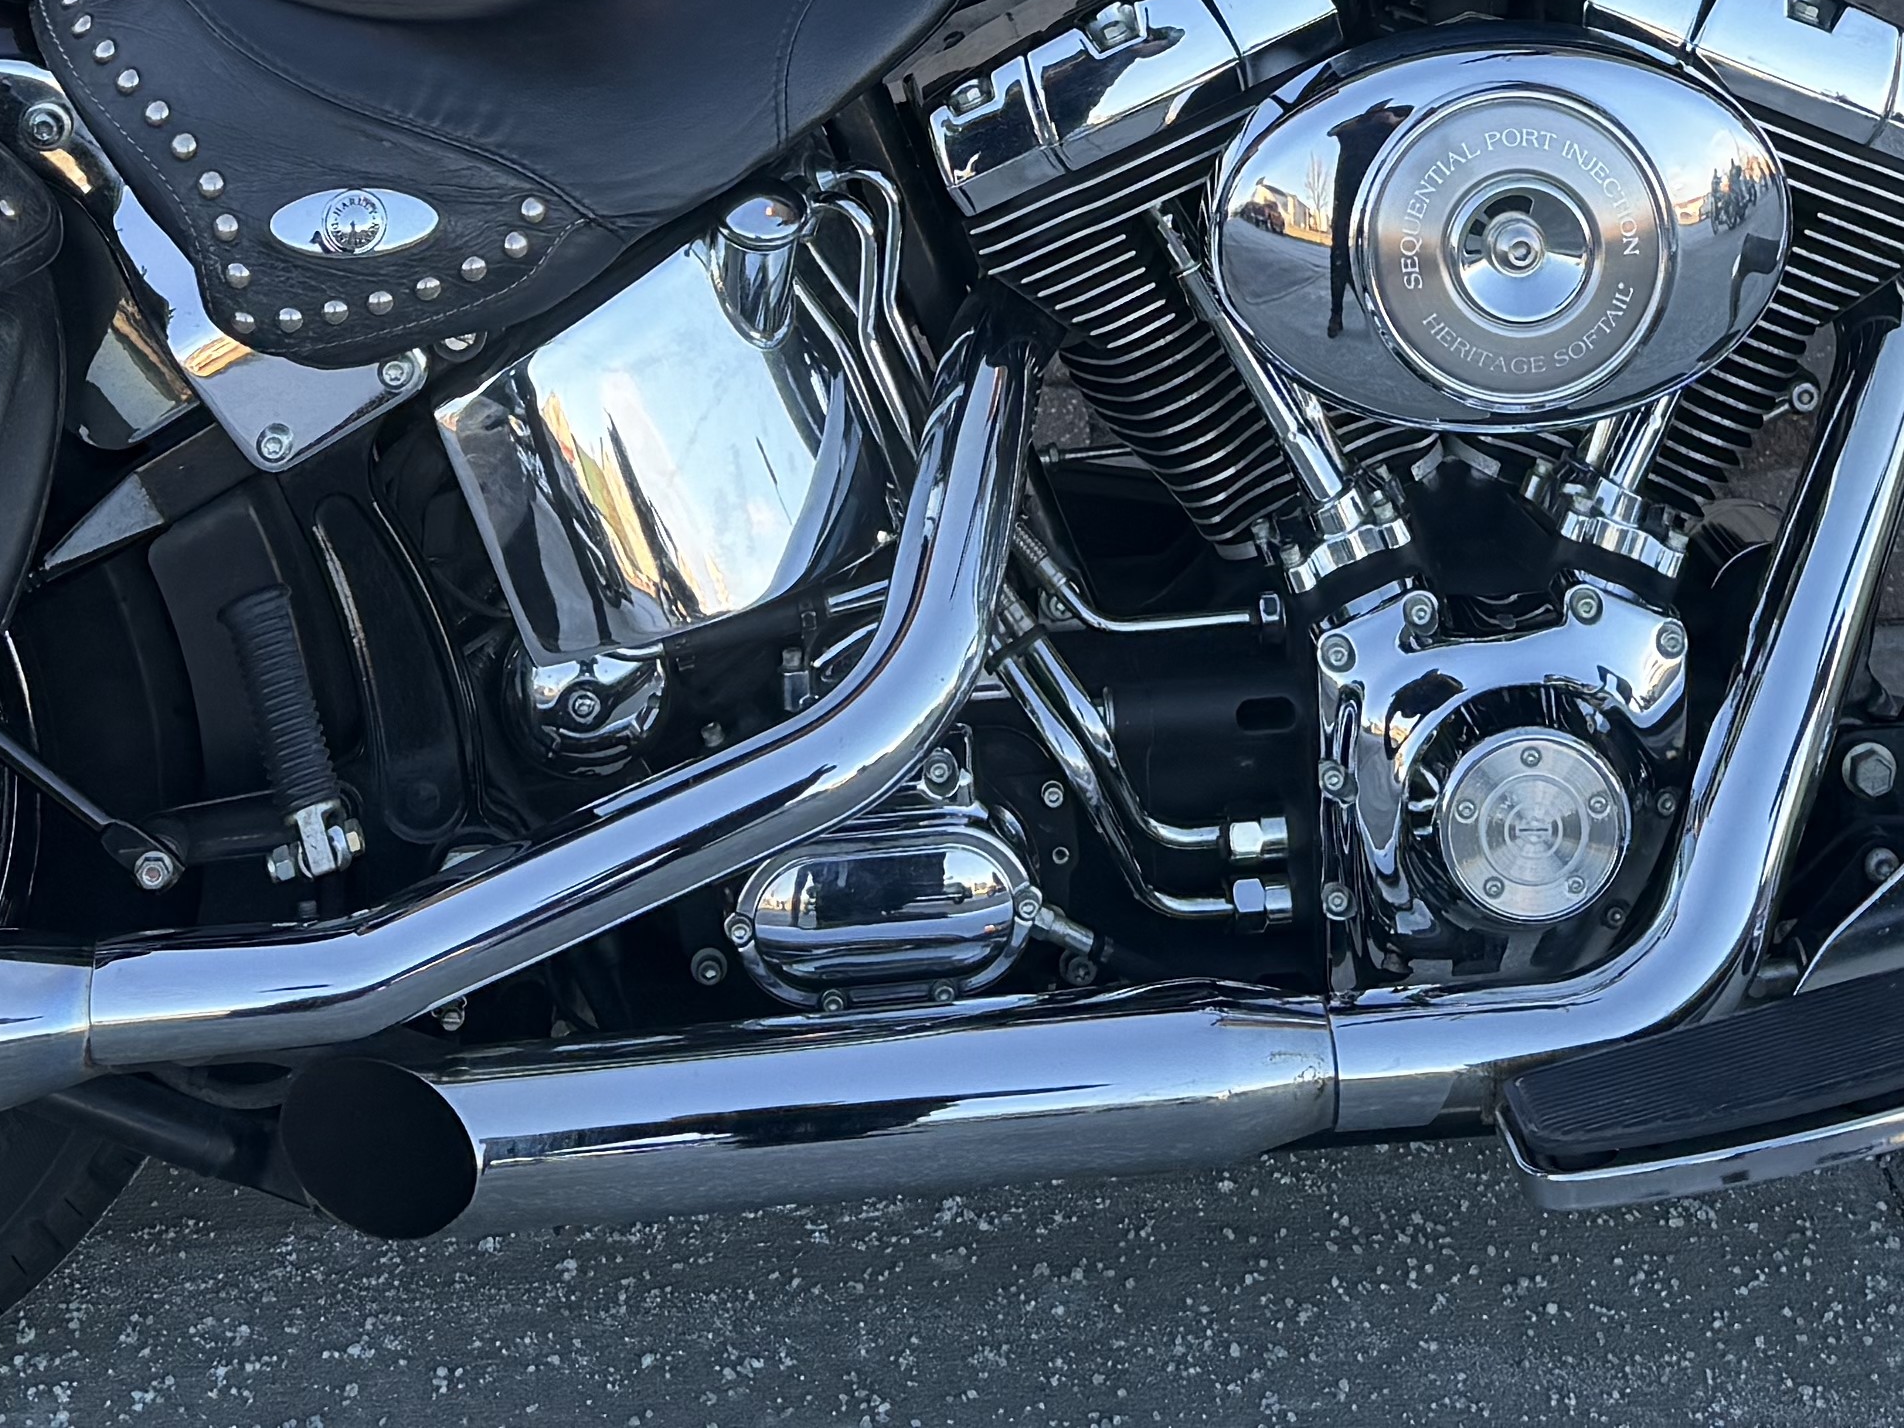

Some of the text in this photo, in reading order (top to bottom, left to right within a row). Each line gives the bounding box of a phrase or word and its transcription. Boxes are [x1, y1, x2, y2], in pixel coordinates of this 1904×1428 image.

[1400, 128, 1640, 291] SEQUENTIAL PORT INJECTION
[1422, 312, 1548, 375] HERITAGE
